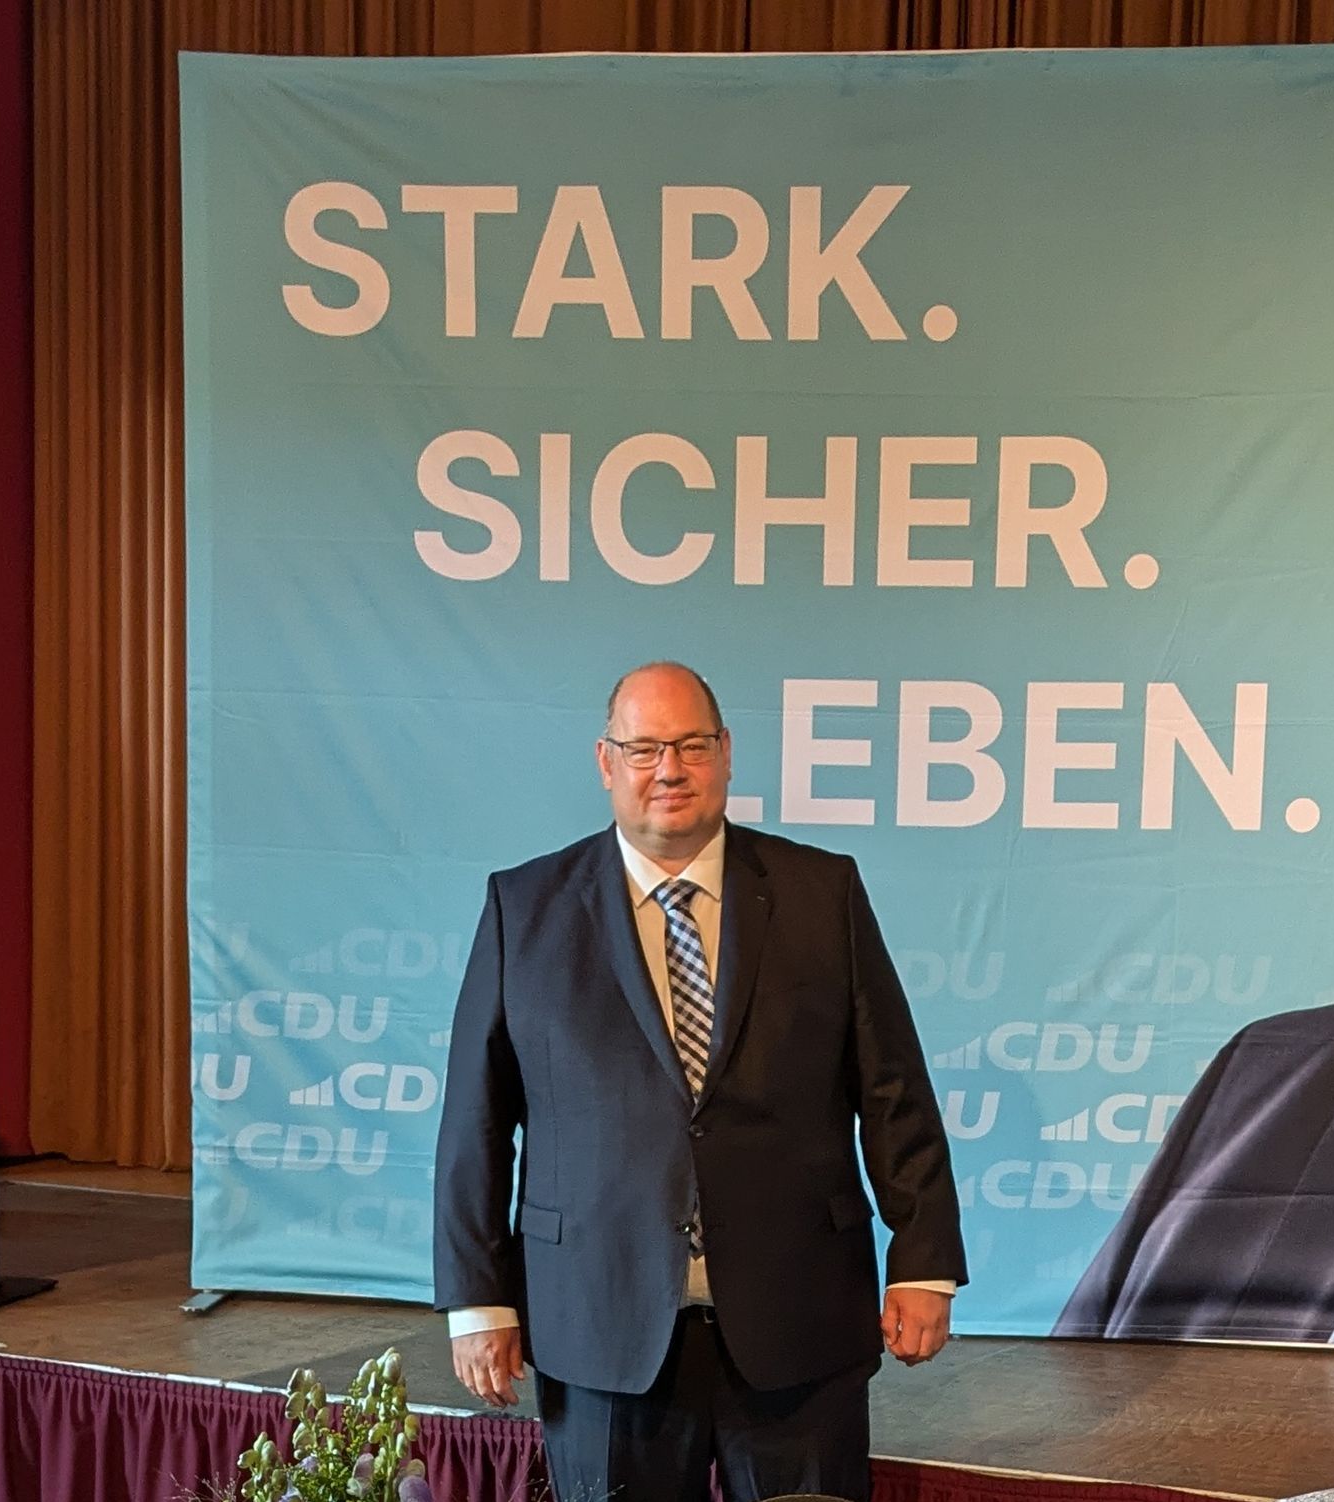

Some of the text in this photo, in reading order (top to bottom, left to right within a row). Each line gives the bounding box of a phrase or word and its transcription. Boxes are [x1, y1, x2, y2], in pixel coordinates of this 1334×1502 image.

[280, 180, 959, 342] STARK.
[413, 428, 1160, 591] SICHER.
[724, 677, 1321, 833] EBEN.
[896, 950, 1005, 1001] DU
[237, 989, 390, 1043] CDU
[985, 1020, 1156, 1073] CDU
[338, 1062, 439, 1113] CD
[1094, 1093, 1187, 1143] CD
[233, 1121, 389, 1176] CDU
